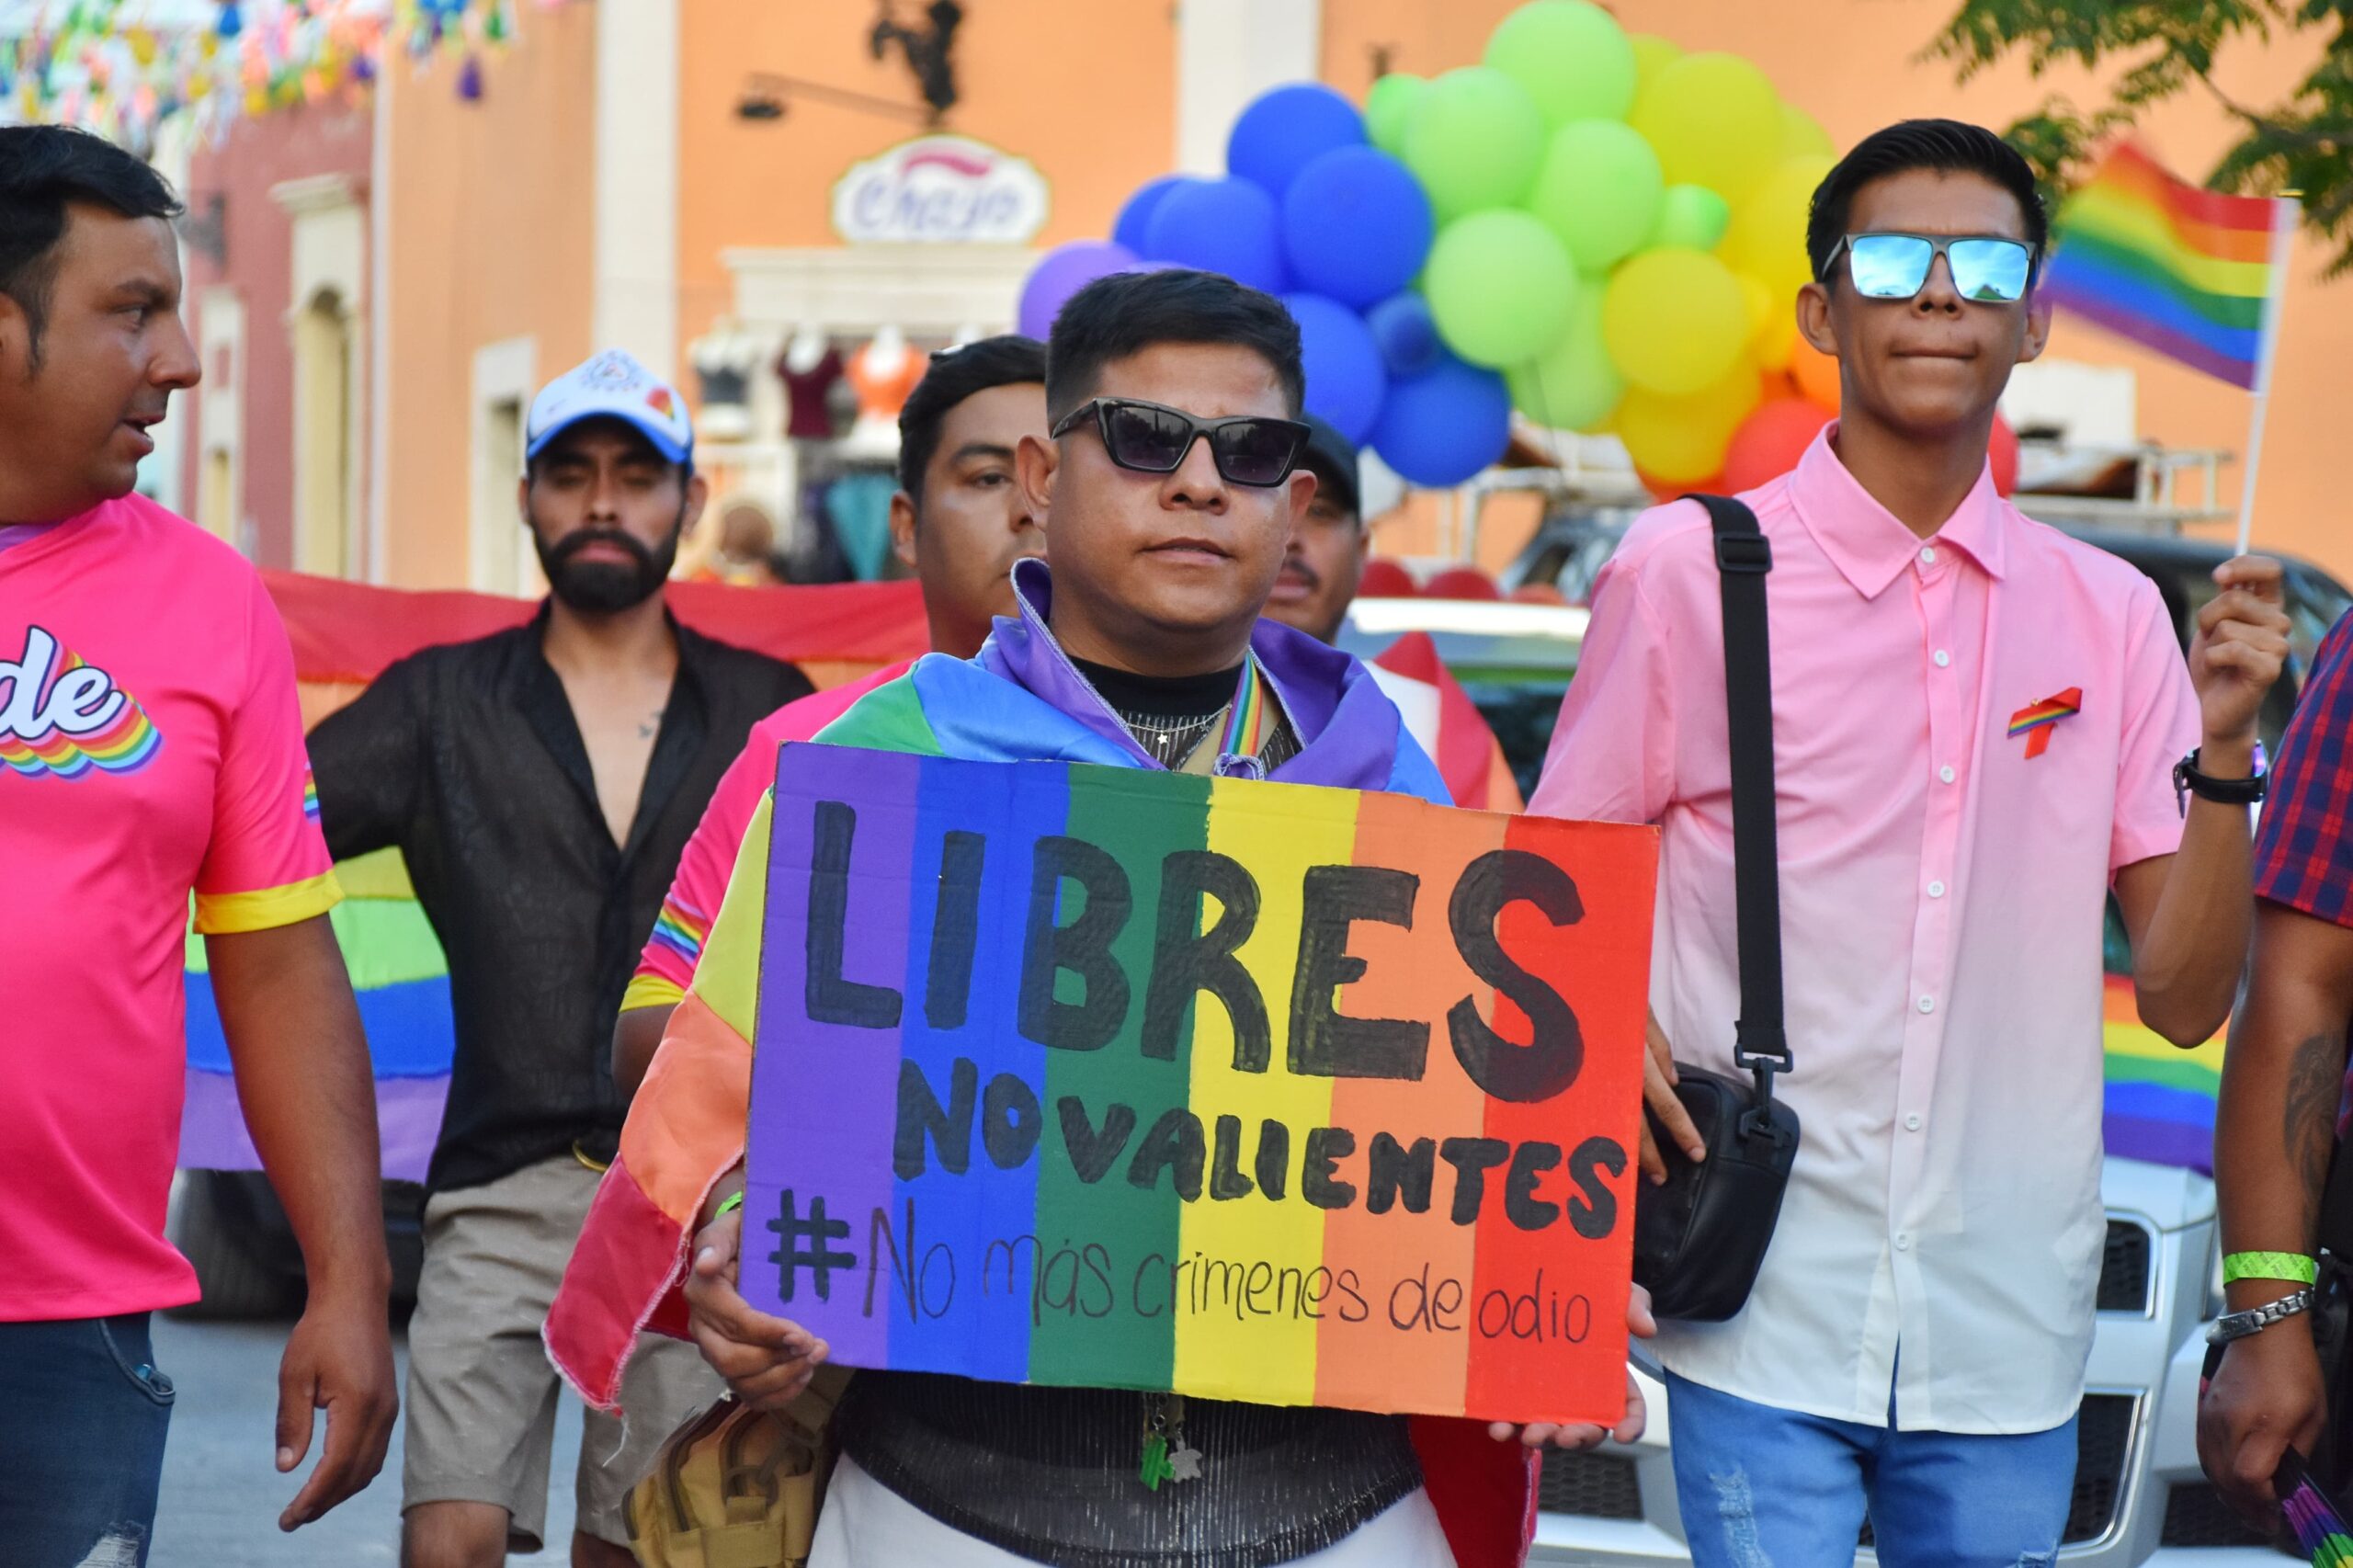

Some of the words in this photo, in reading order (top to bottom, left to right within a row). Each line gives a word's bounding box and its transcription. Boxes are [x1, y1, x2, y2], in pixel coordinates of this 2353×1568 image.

[805, 801, 1585, 1102] LIBRES
[892, 1057, 1043, 1182] NO
[1057, 1096, 1628, 1239] VALIENTES
[1389, 1262, 1462, 1333] de
[1478, 1267, 1590, 1344] odio
